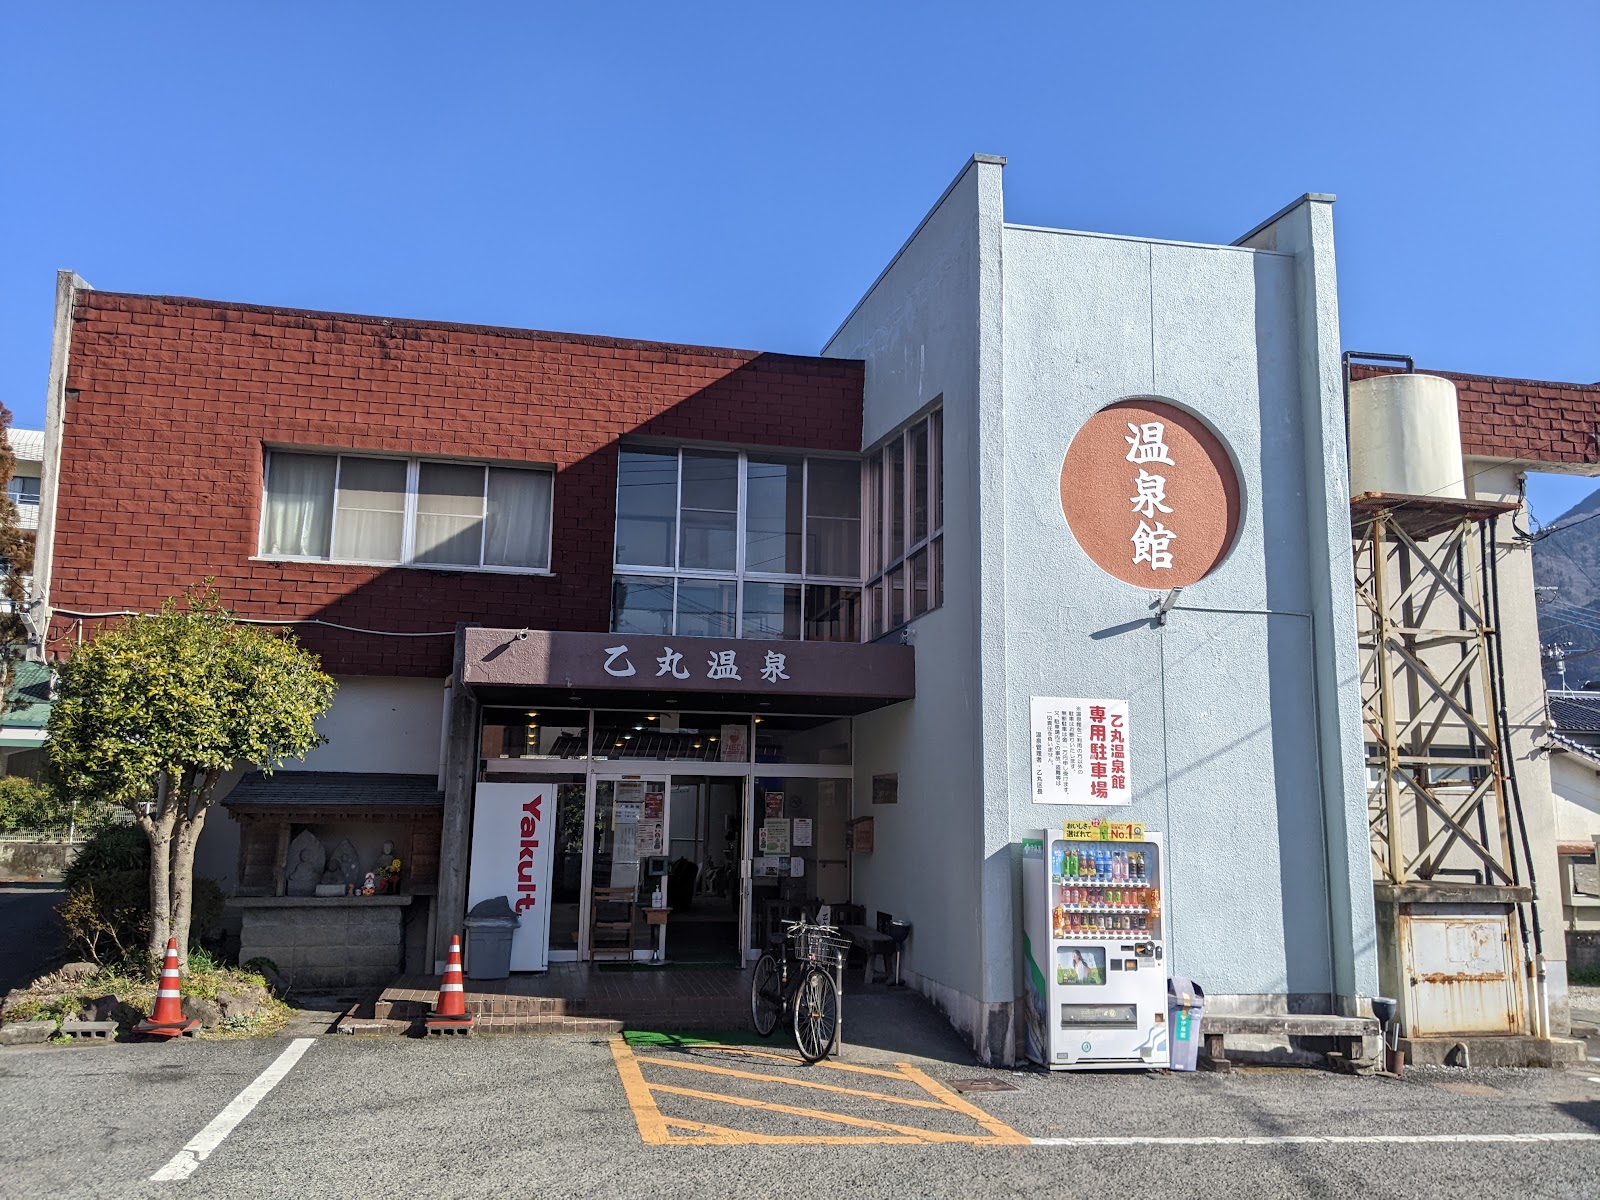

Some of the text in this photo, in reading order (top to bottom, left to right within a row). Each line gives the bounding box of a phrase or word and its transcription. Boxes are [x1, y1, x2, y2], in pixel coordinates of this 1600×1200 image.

[1124, 421, 1177, 570] 温泉館
[603, 644, 791, 684] 乙丸温泉
[1089, 705, 1108, 799] 専用駐車場
[1110, 714, 1125, 790] 乙丸温泉館
[515, 793, 543, 915] Yakult
[1110, 823, 1133, 839] No.1
